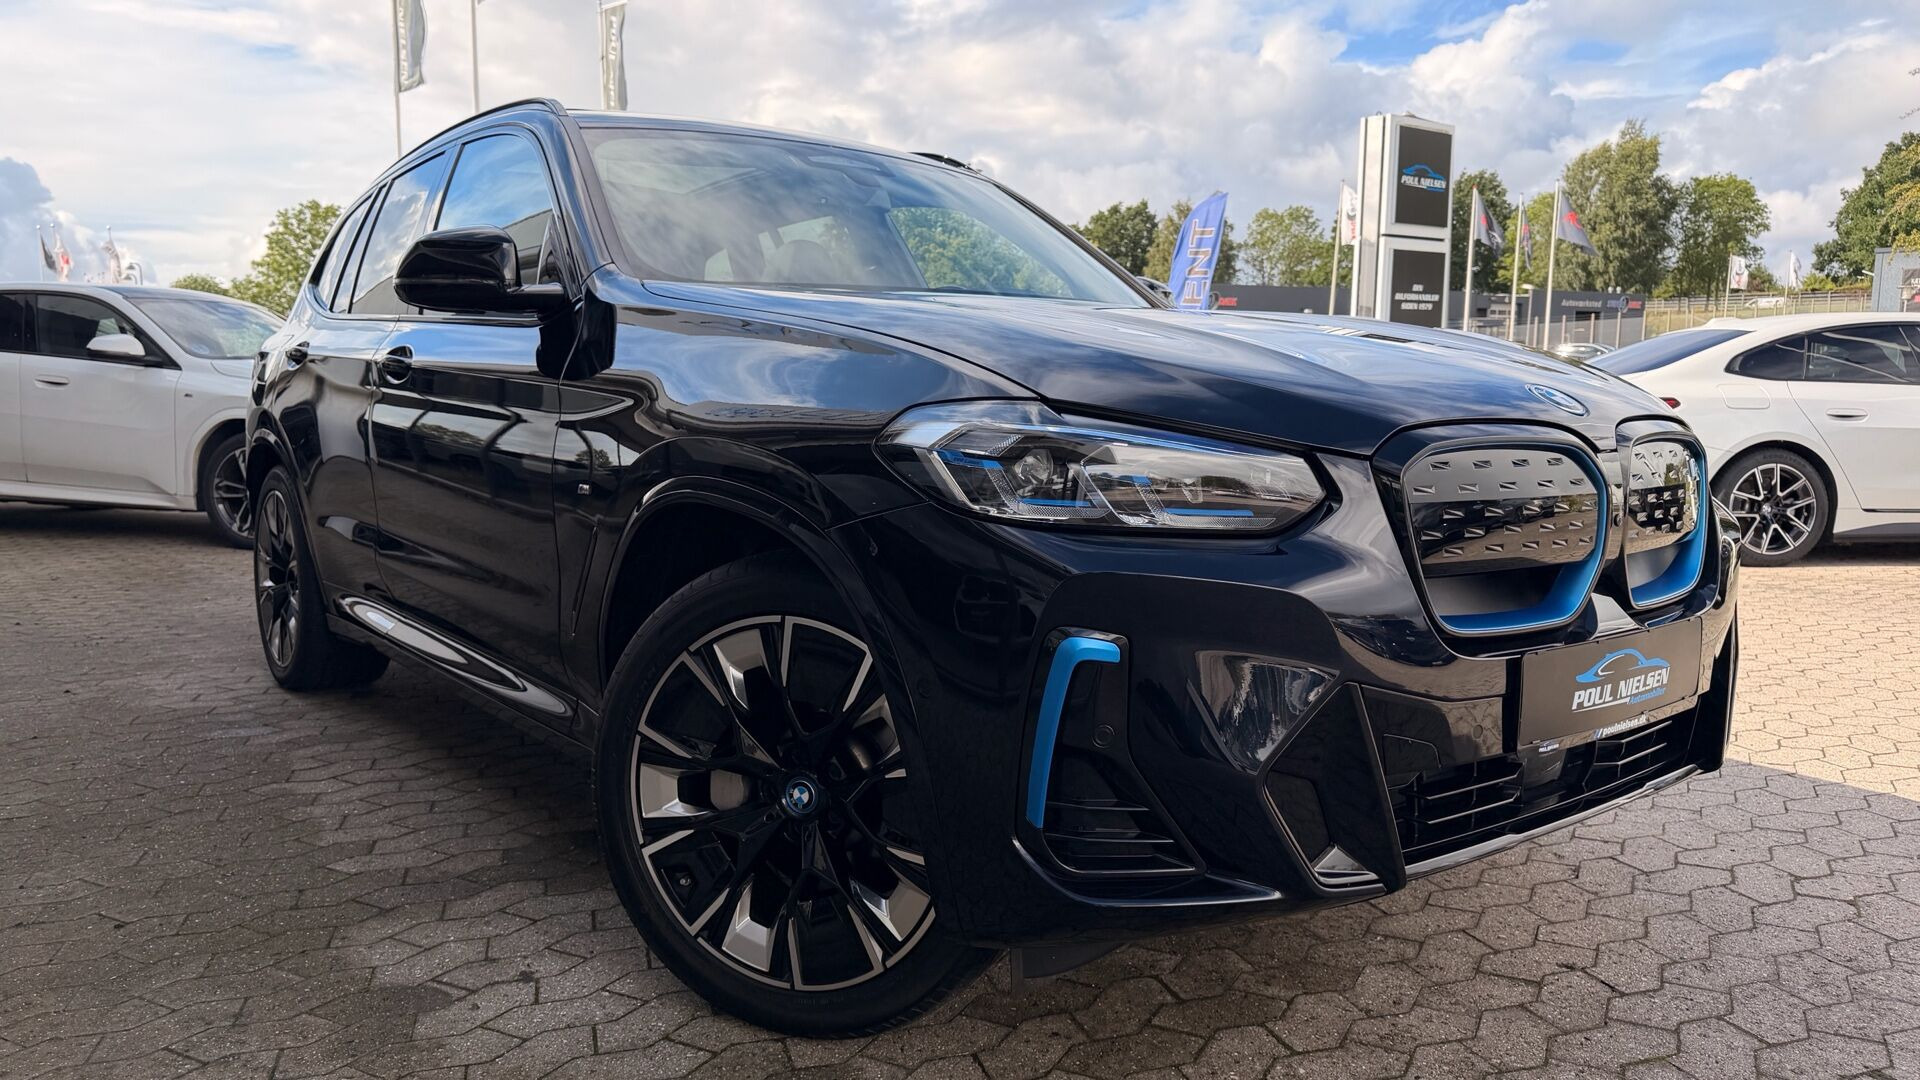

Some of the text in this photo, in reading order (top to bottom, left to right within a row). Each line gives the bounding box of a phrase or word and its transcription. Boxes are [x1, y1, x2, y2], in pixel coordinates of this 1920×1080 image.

[1400, 175, 1419, 185] POUL
[1420, 177, 1447, 189] NIELSEN
[1181, 219, 1216, 309] ENT
[1571, 667, 1671, 710] POUL NIELSEN
